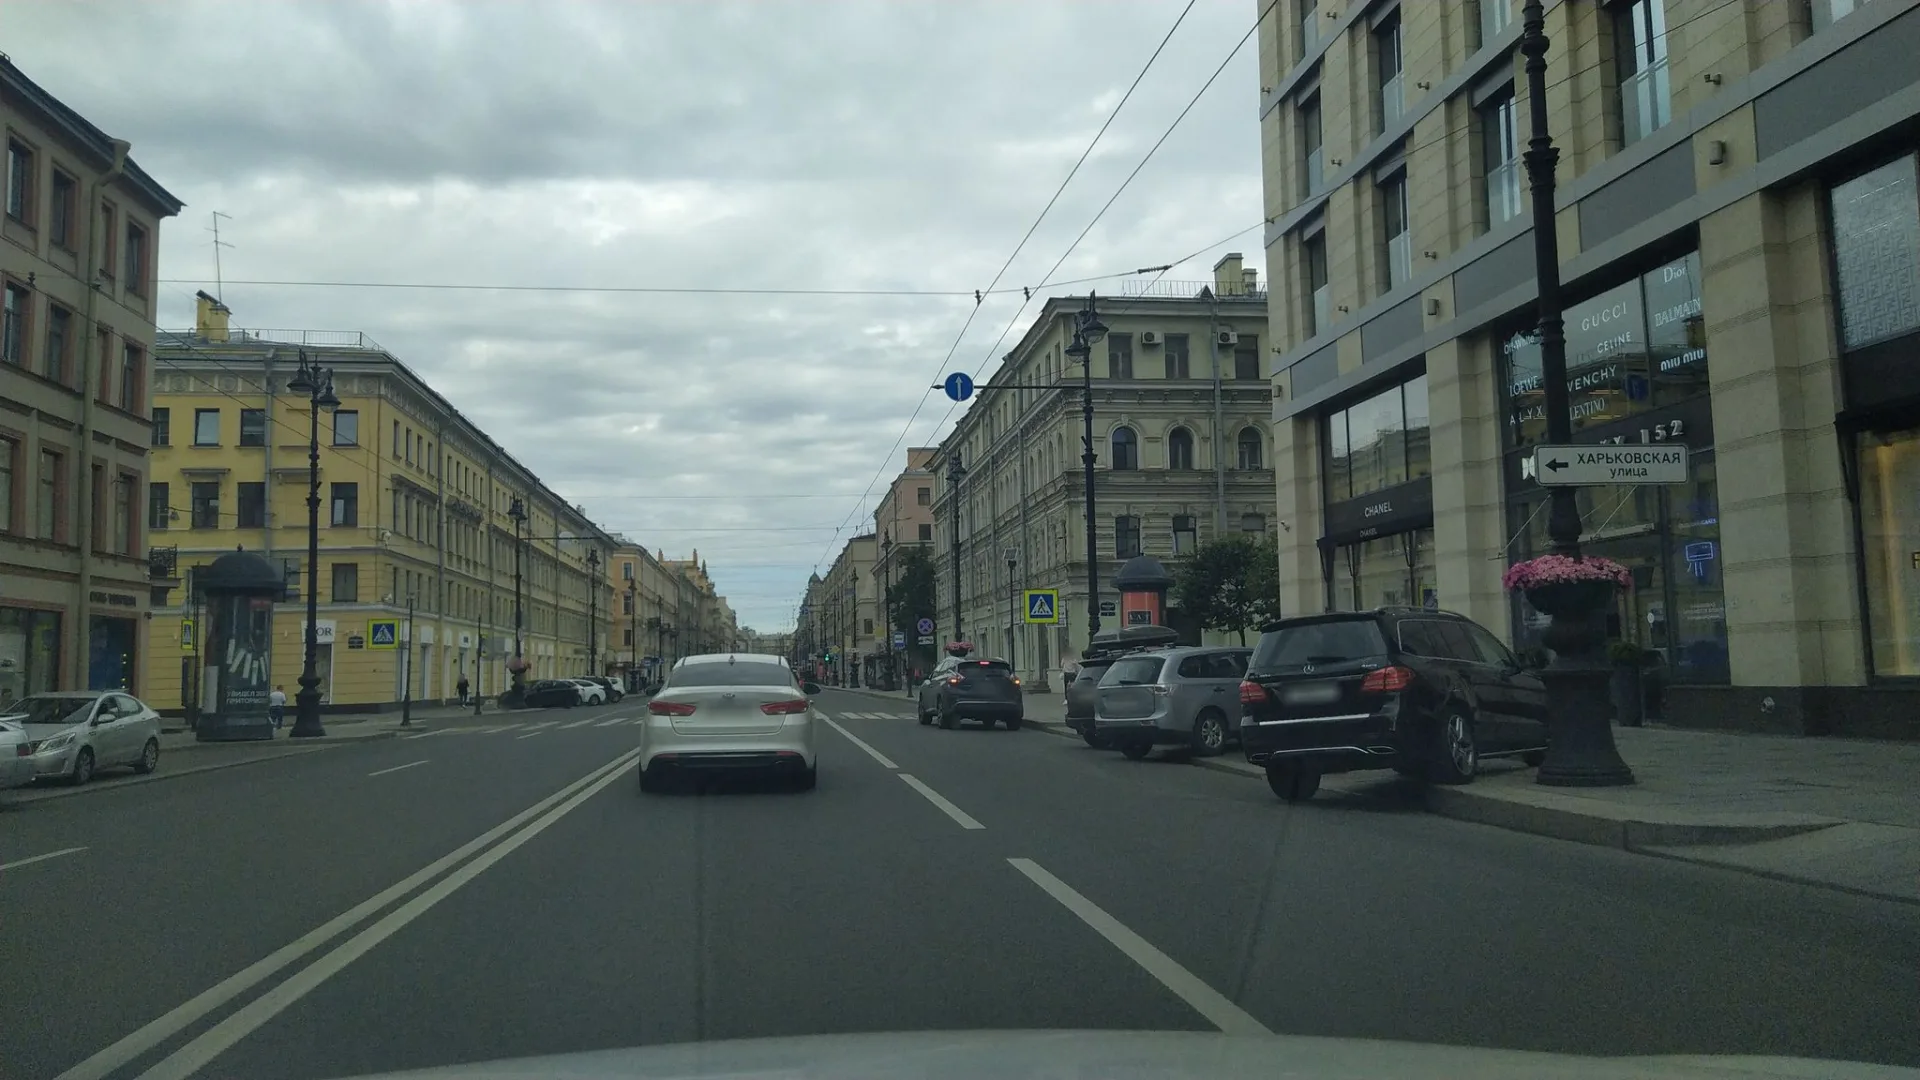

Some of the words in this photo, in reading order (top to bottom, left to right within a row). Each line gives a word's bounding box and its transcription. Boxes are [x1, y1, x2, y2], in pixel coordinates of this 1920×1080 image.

[1663, 266, 1686, 283] Dior
[1581, 301, 1628, 331] GUCCI
[1653, 297, 1701, 327] BALMAIN
[1597, 331, 1631, 354] CELINE
[1509, 375, 1539, 397] LOEWE
[1566, 364, 1618, 393] VENCHY
[1569, 397, 1606, 421] LENTINO
[1640, 419, 1684, 444] 152
[1577, 452, 1681, 465] ХАРЬКОВСКАЯ
[1610, 467, 1648, 479] улица
[1364, 500, 1393, 518] CHANEL
